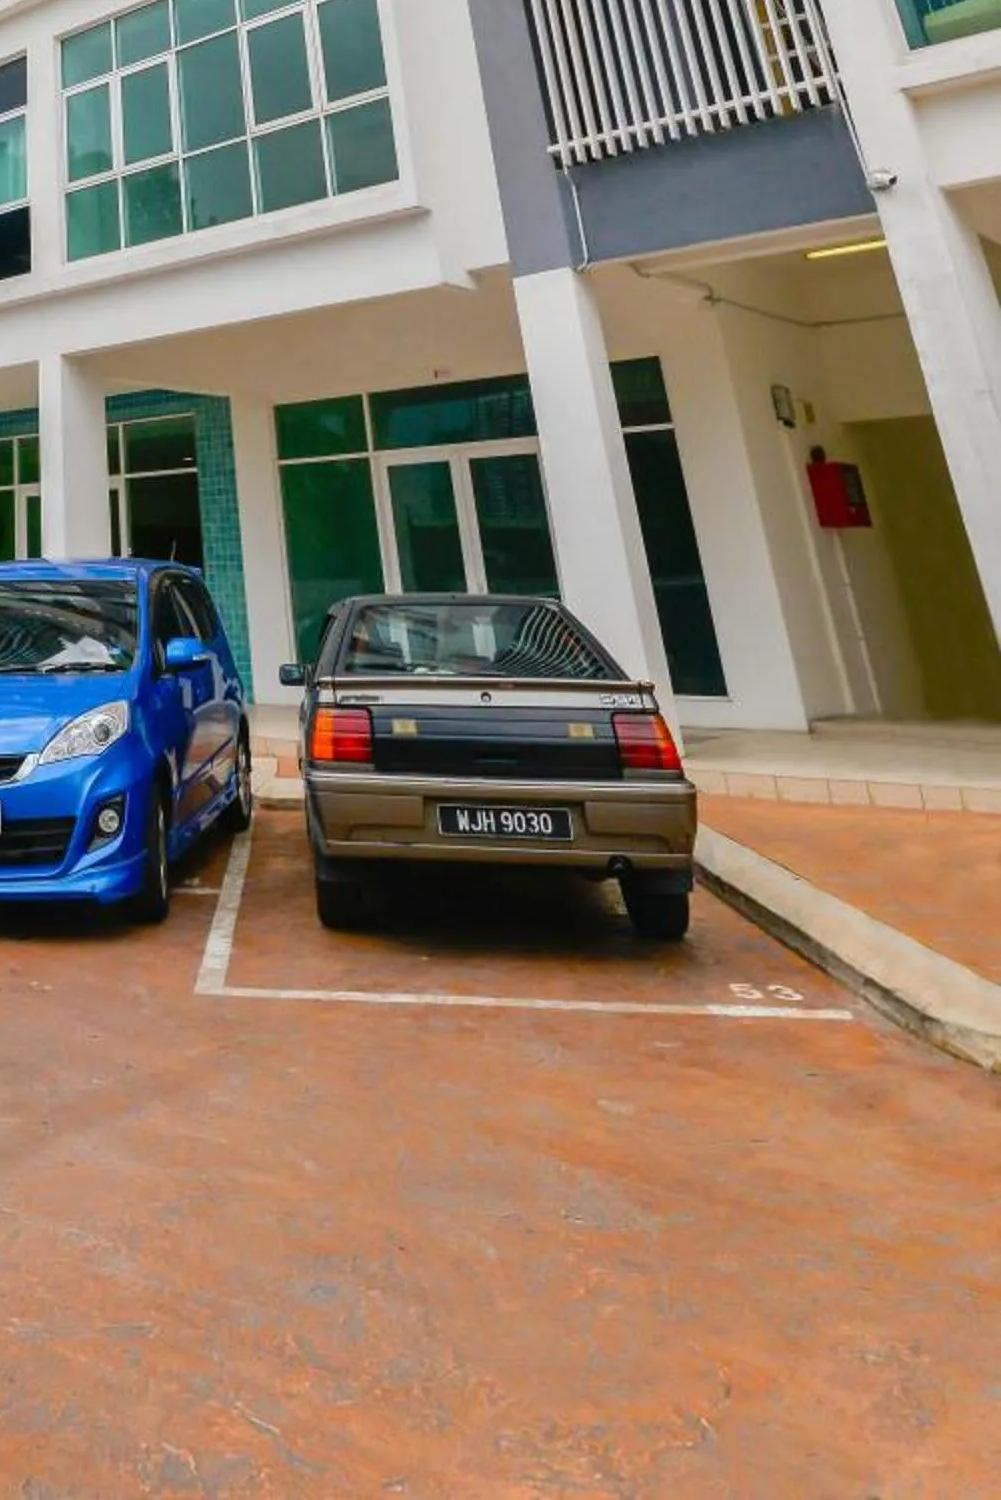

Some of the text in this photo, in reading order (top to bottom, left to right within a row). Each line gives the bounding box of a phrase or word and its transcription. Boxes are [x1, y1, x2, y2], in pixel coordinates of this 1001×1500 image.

[456, 809, 553, 834] WJH 9030
[728, 982, 804, 1001] 53
